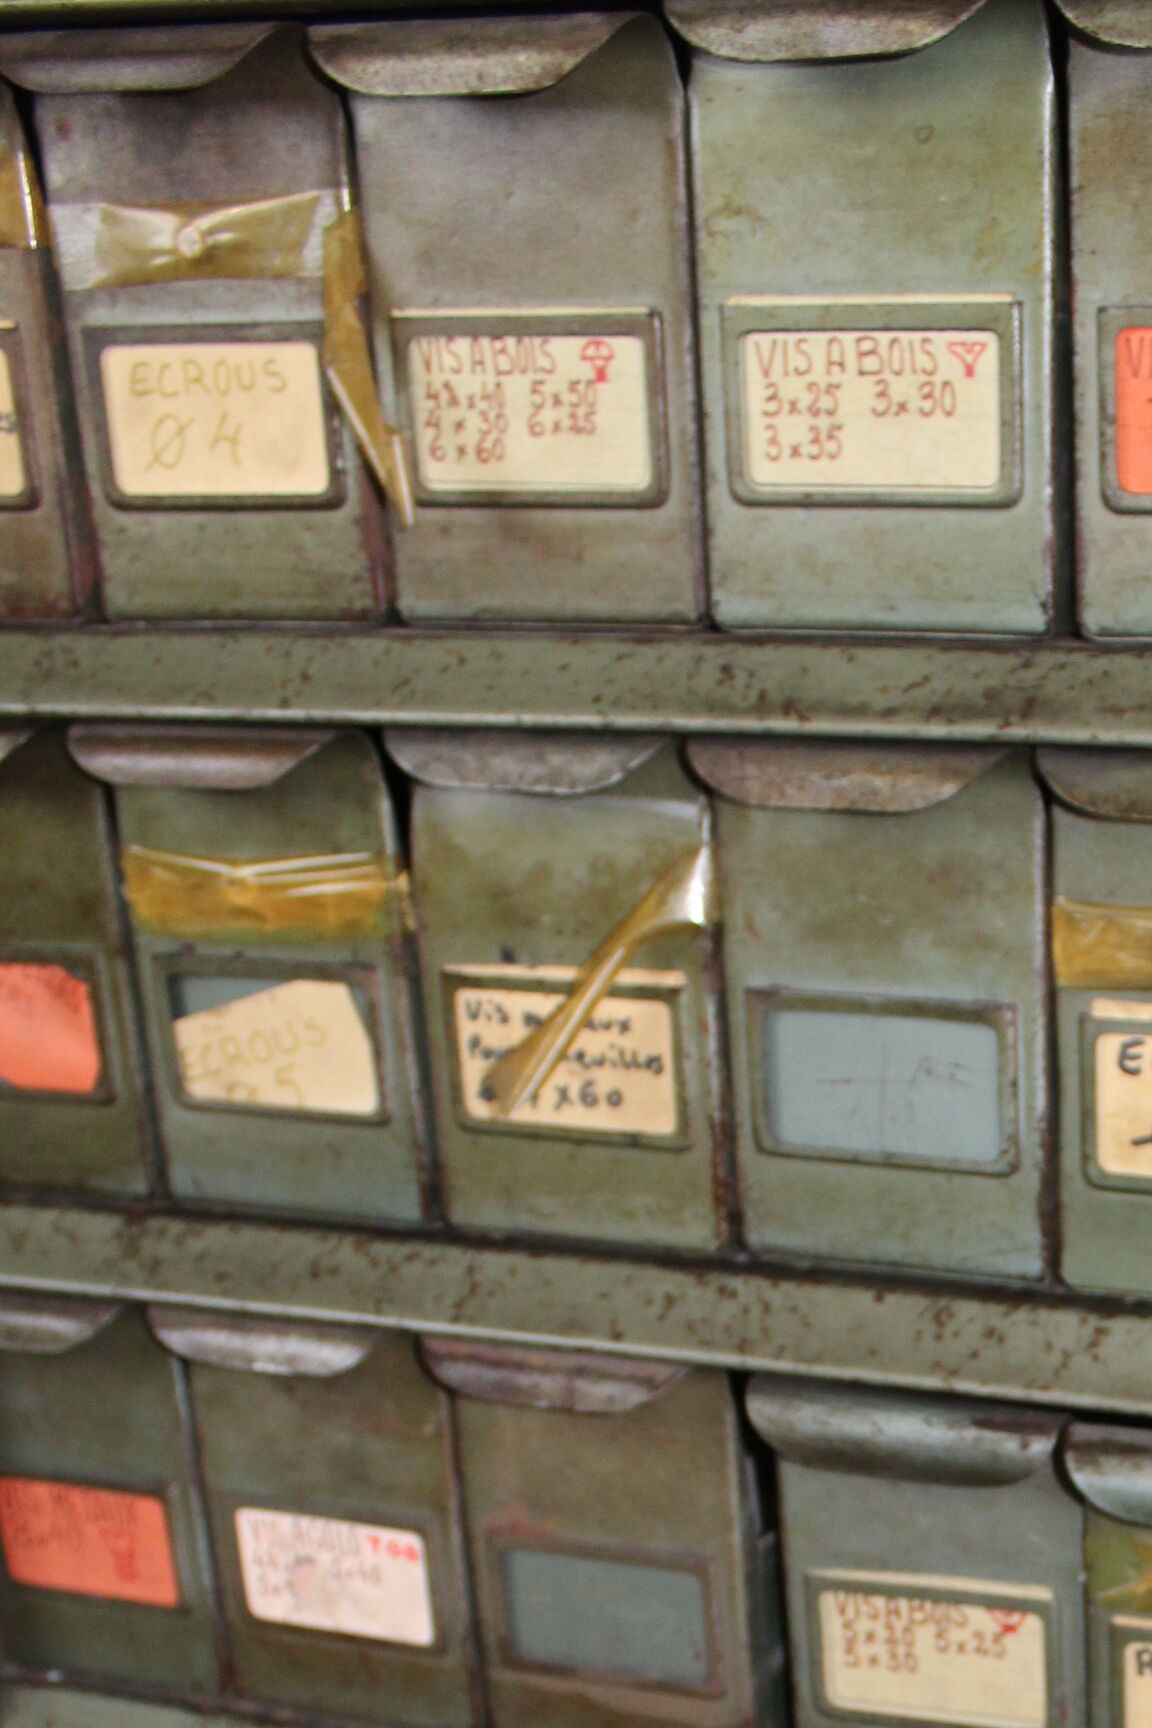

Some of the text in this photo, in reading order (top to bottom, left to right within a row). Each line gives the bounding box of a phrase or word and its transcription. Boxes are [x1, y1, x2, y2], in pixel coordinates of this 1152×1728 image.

[130, 357, 288, 399] ECROUS
[416, 337, 558, 376] VIS A BOIS
[753, 335, 939, 379] VIS A BOIS
[209, 414, 242, 464] 4
